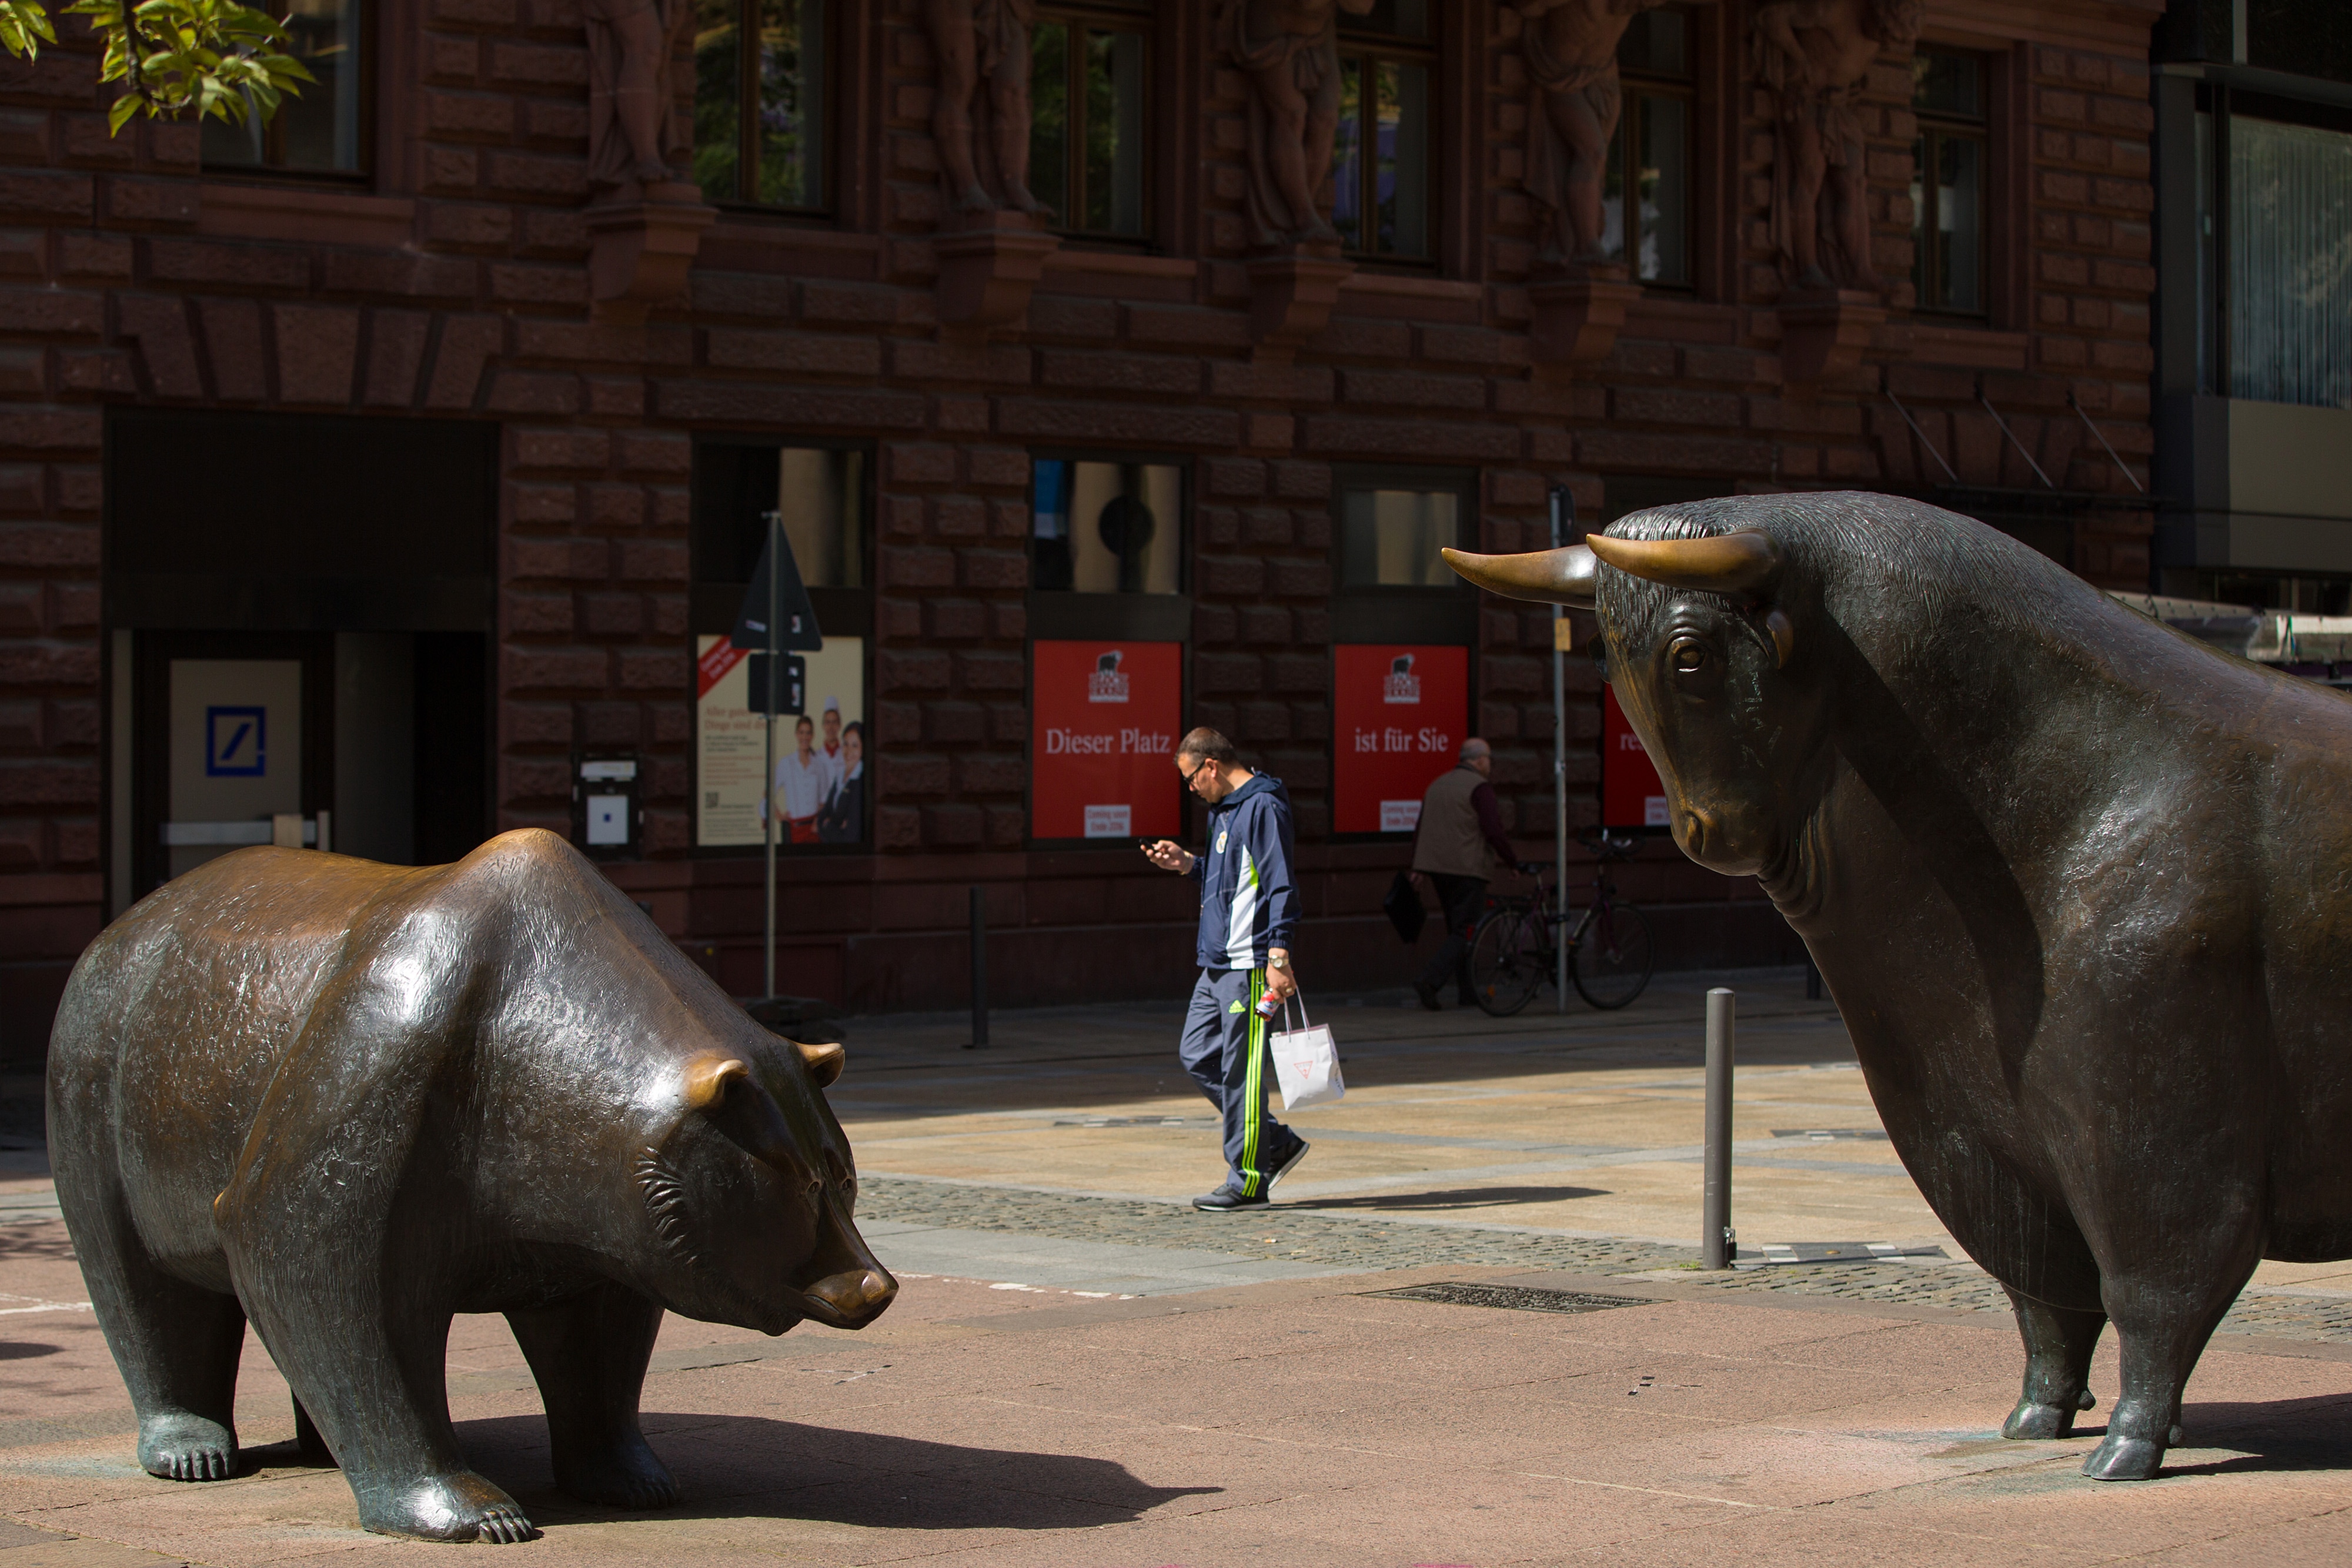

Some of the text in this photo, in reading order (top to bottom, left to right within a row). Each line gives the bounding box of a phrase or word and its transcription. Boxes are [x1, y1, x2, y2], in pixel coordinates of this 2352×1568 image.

[1046, 727, 1171, 754] Dieser Platz
[1355, 727, 1449, 753] ist für Sie
